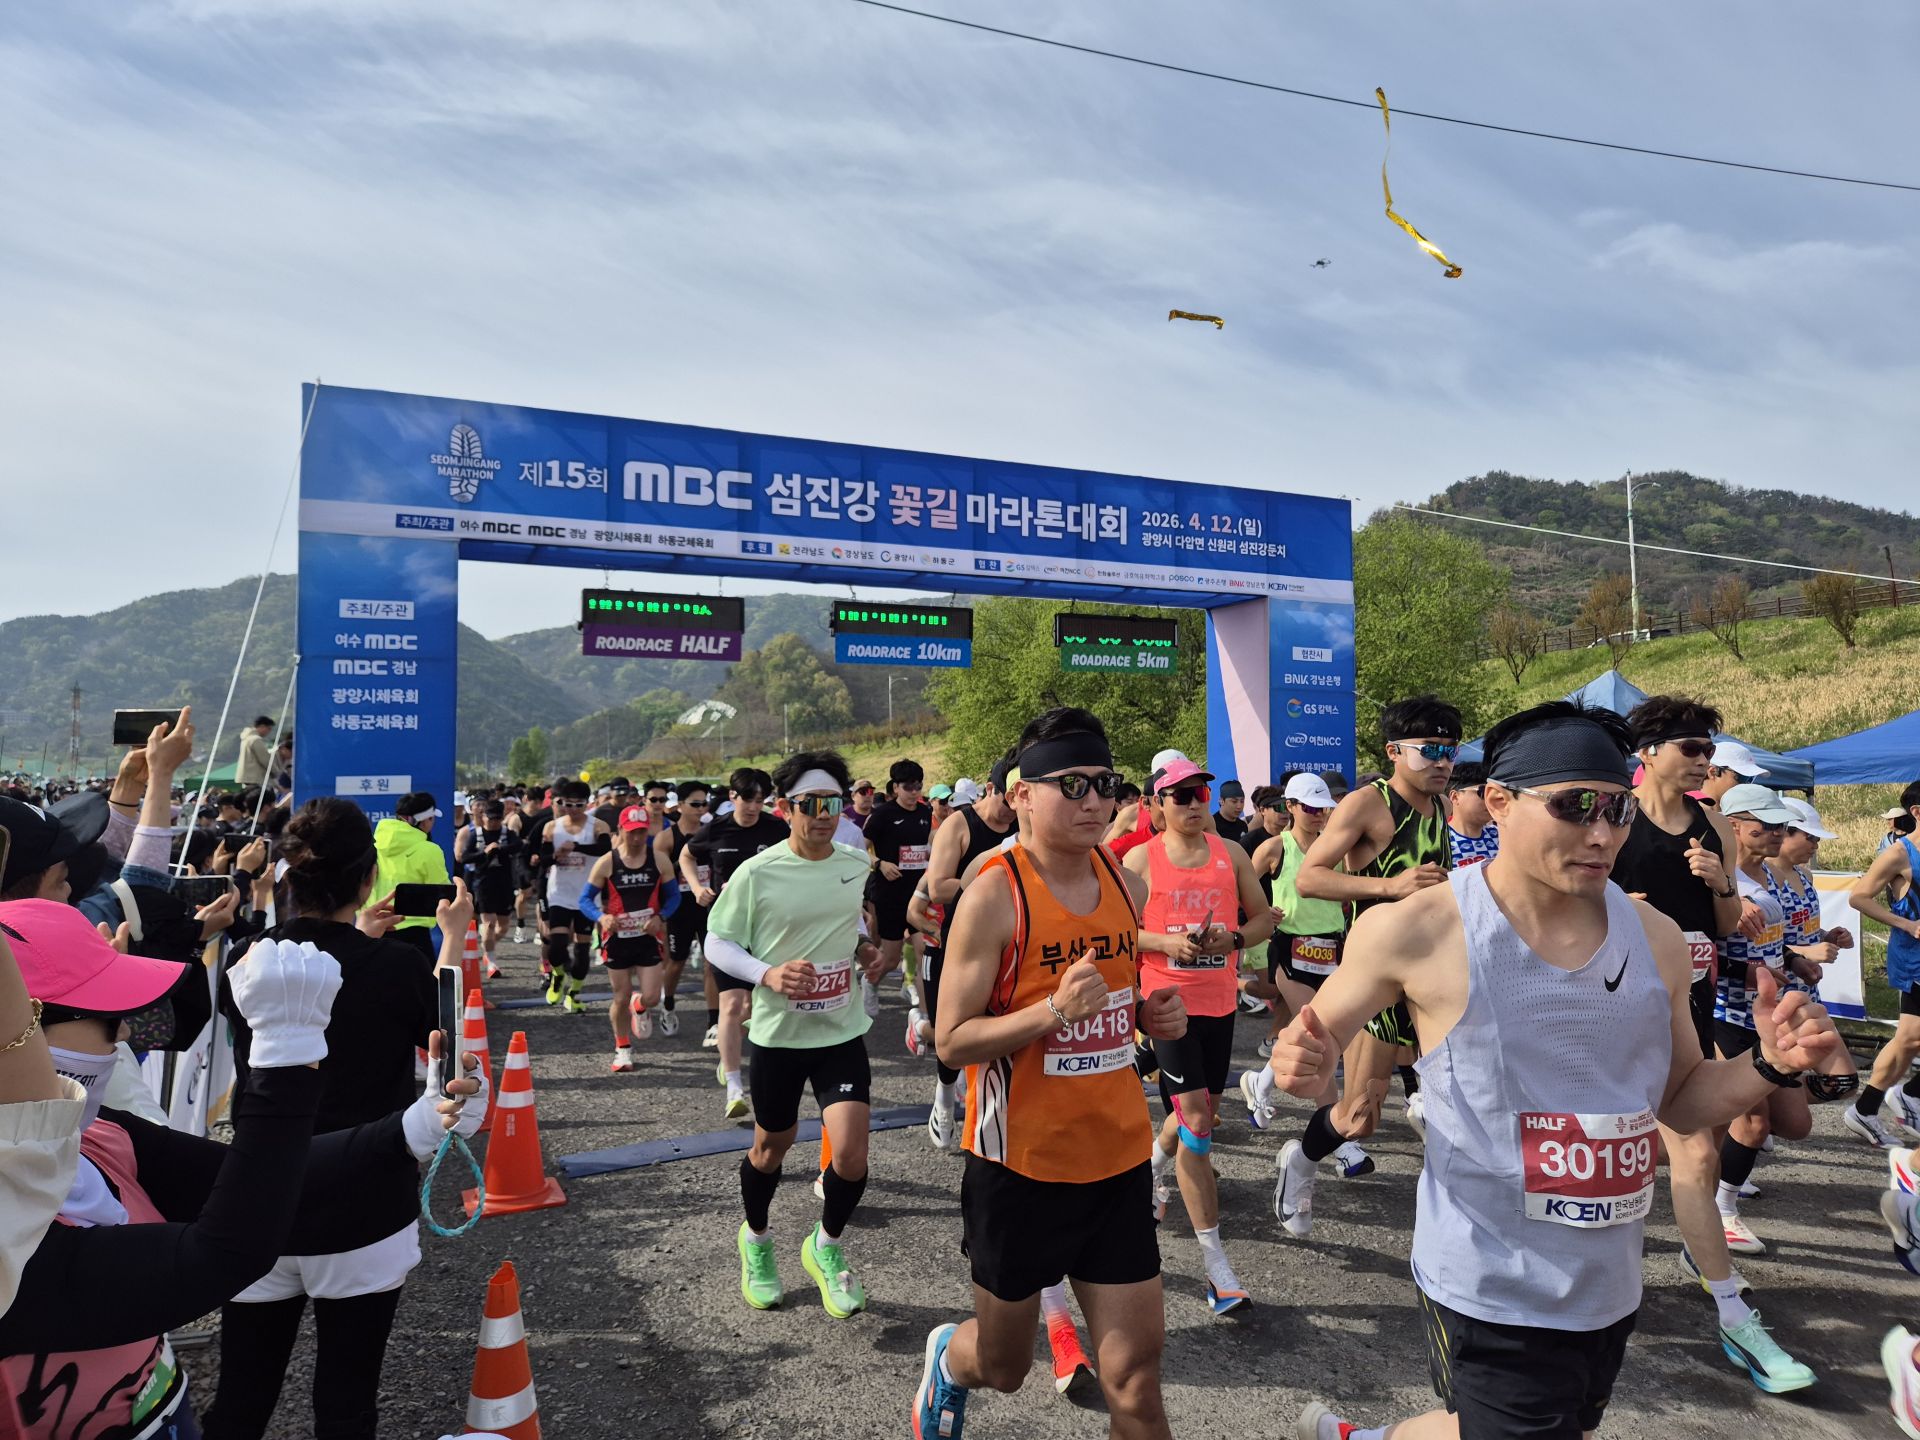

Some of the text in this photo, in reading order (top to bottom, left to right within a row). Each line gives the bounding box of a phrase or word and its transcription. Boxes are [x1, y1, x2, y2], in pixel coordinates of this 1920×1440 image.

[430, 454, 501, 470] SEOMJINGANG
[437, 466, 494, 480] MARATHON
[519, 459, 1127, 545] 제15회 MBC 섬진강 꽃길 마라톤대회
[400, 515, 450, 530] 주최/주관
[1142, 511, 1184, 529] 2026.
[1189, 512, 1206, 531] 4.
[461, 520, 714, 548] 여수 MBC MBC 경남 광양시체육회 하동군체육회
[793, 546, 825, 557] 전라남도
[1142, 533, 1286, 558] 광양시 다압면 신원리 섬진강둔치
[346, 603, 408, 617] 주최/주관
[335, 633, 418, 650] 여수 MBC
[595, 635, 731, 654] ROADRACE HALF
[847, 642, 962, 661] ROADRACE 10km
[333, 659, 417, 676] MBC 경남
[1071, 652, 1170, 669] ROADRACE 5km
[1284, 673, 1341, 687] BNK 경남은행
[331, 688, 419, 705] 광양시체육회
[1303, 703, 1340, 715] GS 칼텍스
[331, 714, 418, 731] 하동군체육회
[1309, 735, 1341, 746] 여천NCC
[1040, 931, 1135, 974] 부산교사
[1296, 944, 1333, 960] 40038
[795, 1001, 826, 1011] KOEN
[1056, 1009, 1129, 1043] 30418
[1057, 1055, 1100, 1072] KOEN
[1526, 1116, 1566, 1131] HALF
[1539, 1138, 1651, 1180] 30199
[1545, 1198, 1611, 1222] KOEN
[1615, 1211, 1632, 1220] KOREA
